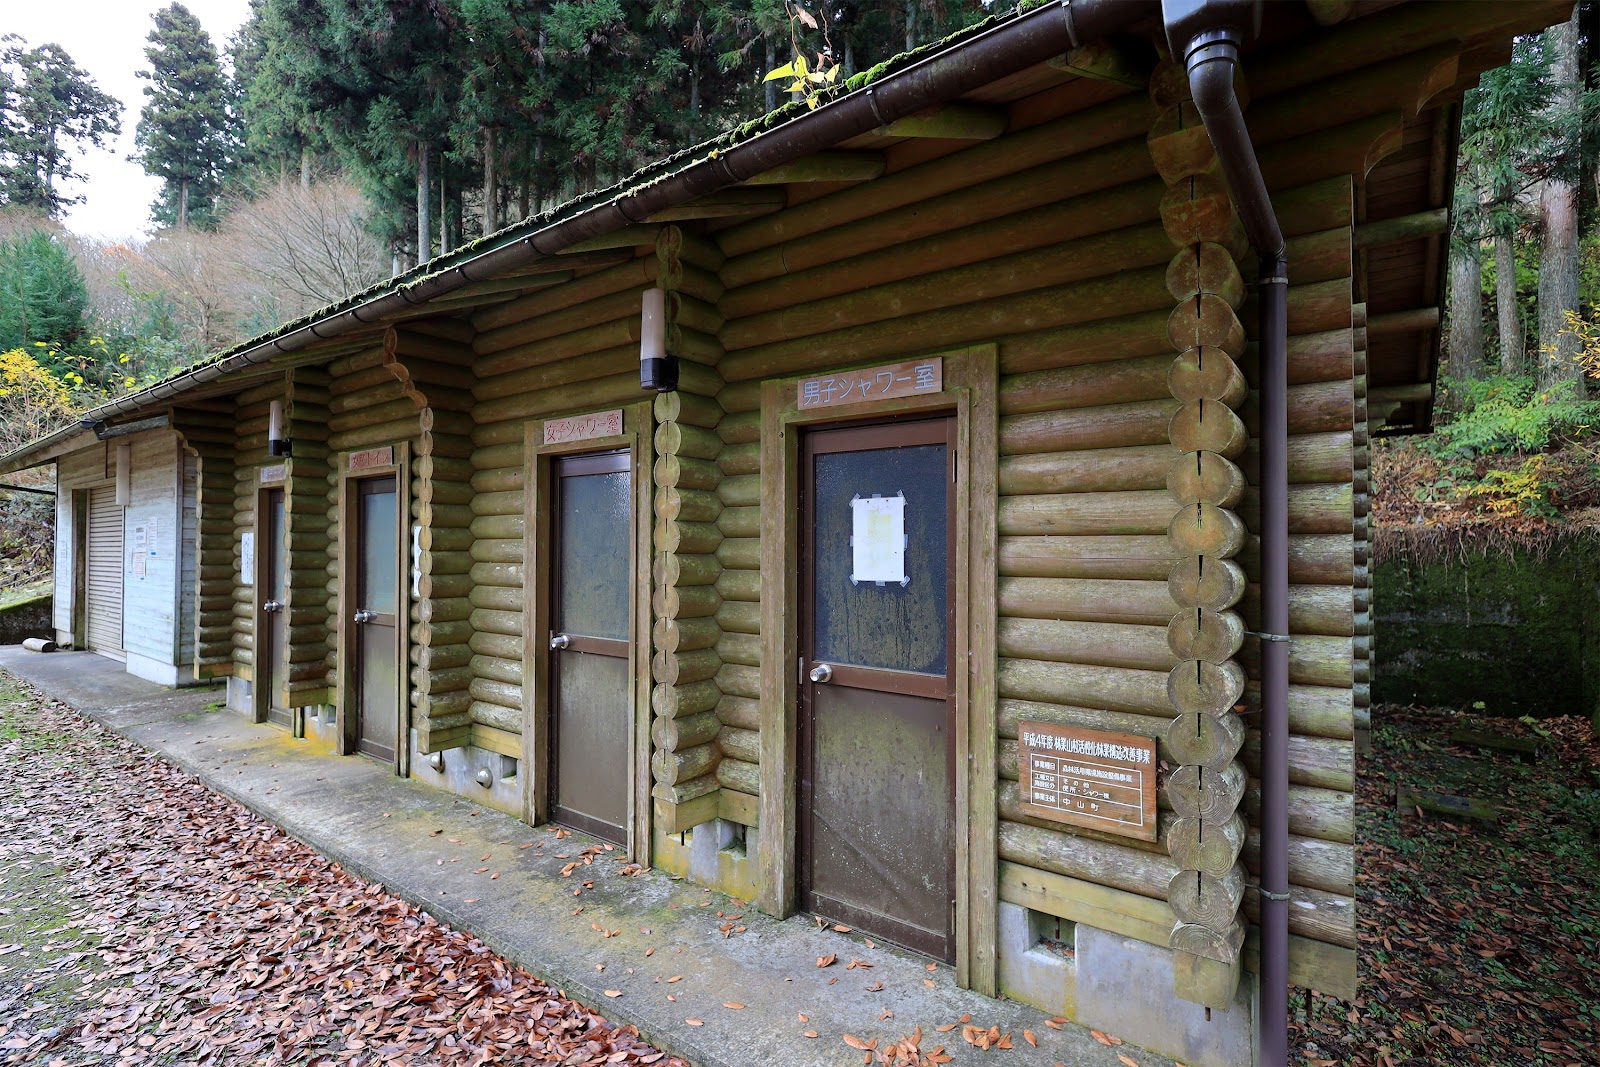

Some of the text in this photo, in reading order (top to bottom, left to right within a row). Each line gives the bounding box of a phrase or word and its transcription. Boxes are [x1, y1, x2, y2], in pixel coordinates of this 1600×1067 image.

[803, 363, 936, 406] 男子シャワー室
[547, 413, 618, 442] 女子シャワー室
[1023, 732, 1053, 749] 平成4年度
[1063, 798, 1099, 812] 中山町
